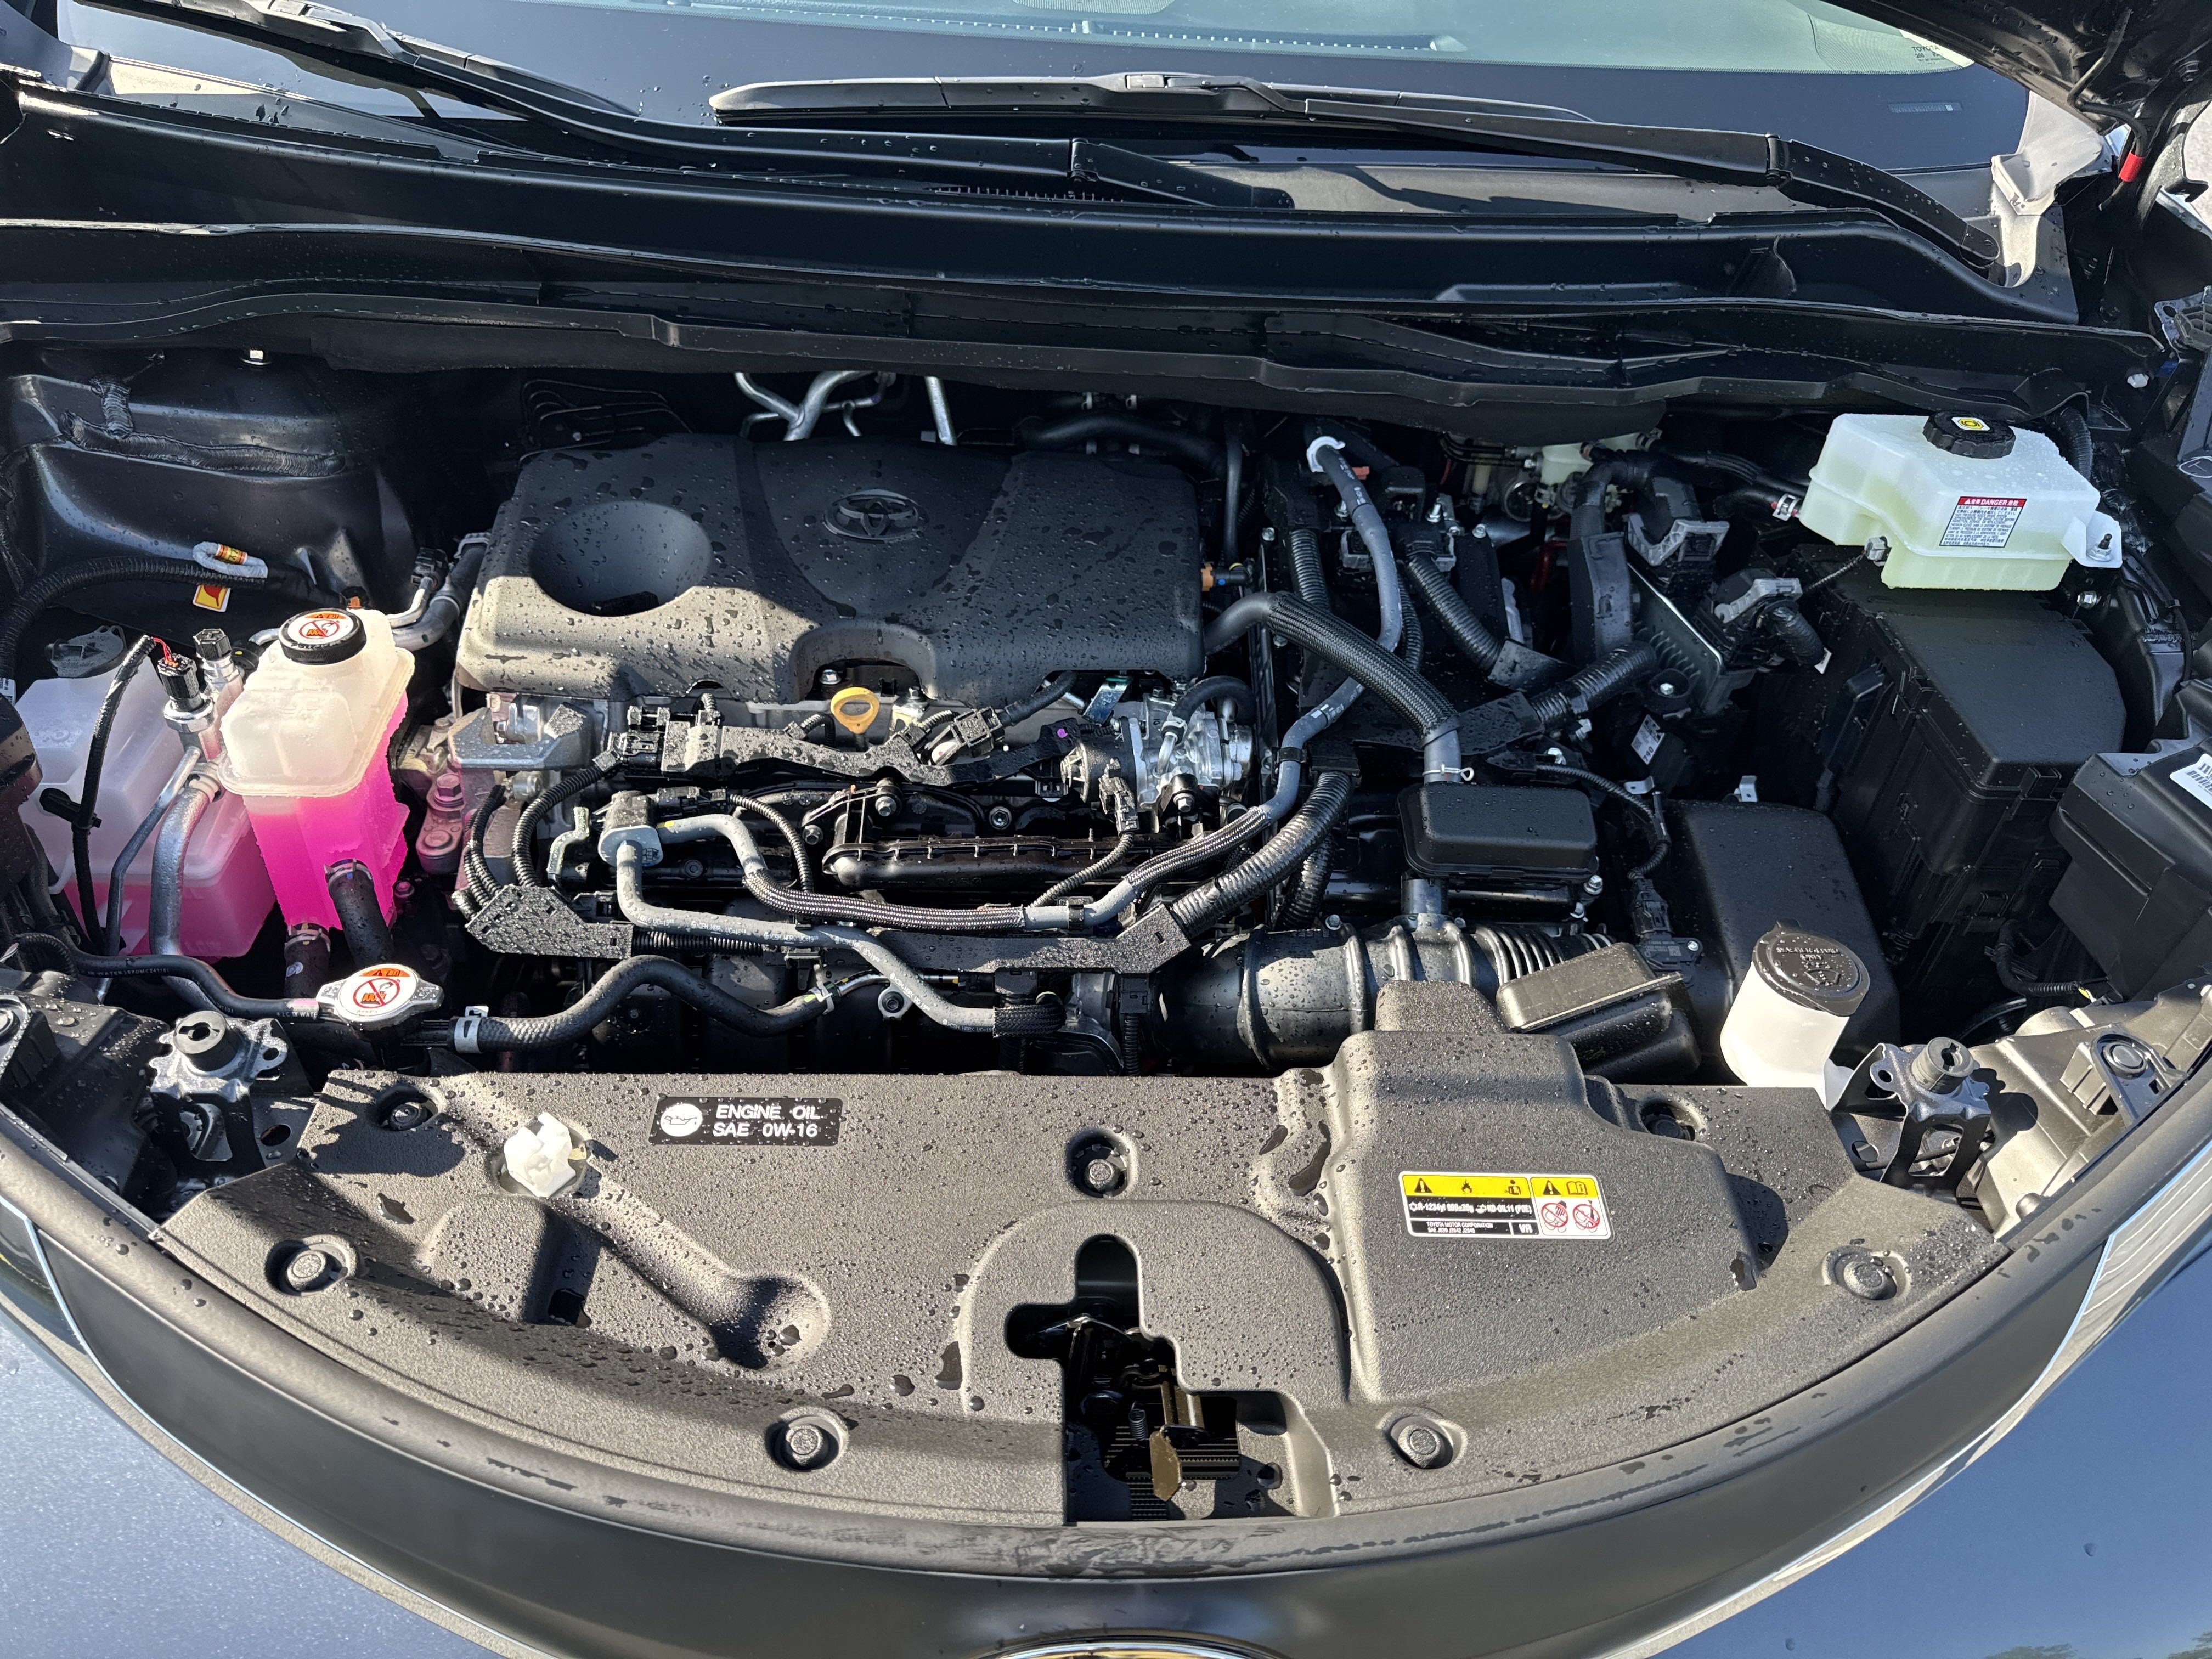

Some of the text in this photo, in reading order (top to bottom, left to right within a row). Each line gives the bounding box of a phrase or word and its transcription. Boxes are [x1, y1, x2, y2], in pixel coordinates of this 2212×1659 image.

[715, 1104, 821, 1119] ENGINE OIL
[712, 1121, 818, 1137] SAE 0W-16
[1515, 1204, 1532, 1214] (POE)
